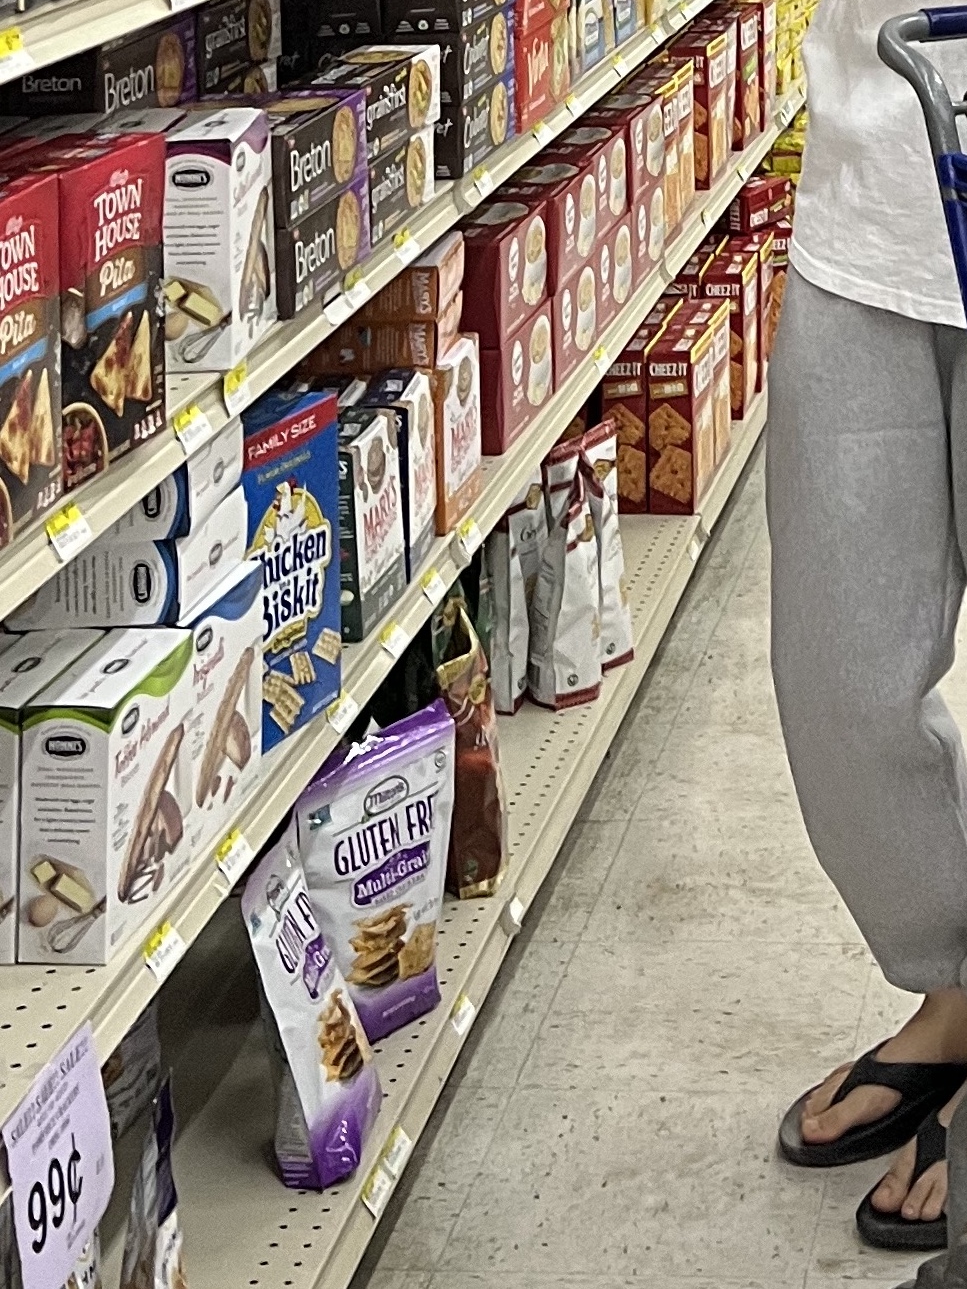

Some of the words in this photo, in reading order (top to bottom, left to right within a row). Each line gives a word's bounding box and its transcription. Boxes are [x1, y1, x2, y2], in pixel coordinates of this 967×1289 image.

[22, 75, 83, 94] Breton
[104, 65, 155, 114] Breton
[290, 140, 332, 193] Breton
[93, 178, 143, 227] TOWN
[94, 213, 142, 262] HOUSE
[295, 227, 336, 284] Breton
[99, 257, 136, 297] Pita
[0, 310, 37, 355] Pita
[247, 430, 289, 460] FAMILY
[289, 415, 317, 440] SIZE
[251, 529, 328, 590] hicken
[334, 813, 401, 876] GLUTEN
[356, 850, 430, 900] Multi-Grai
[28, 1132, 84, 1254] 99¢
